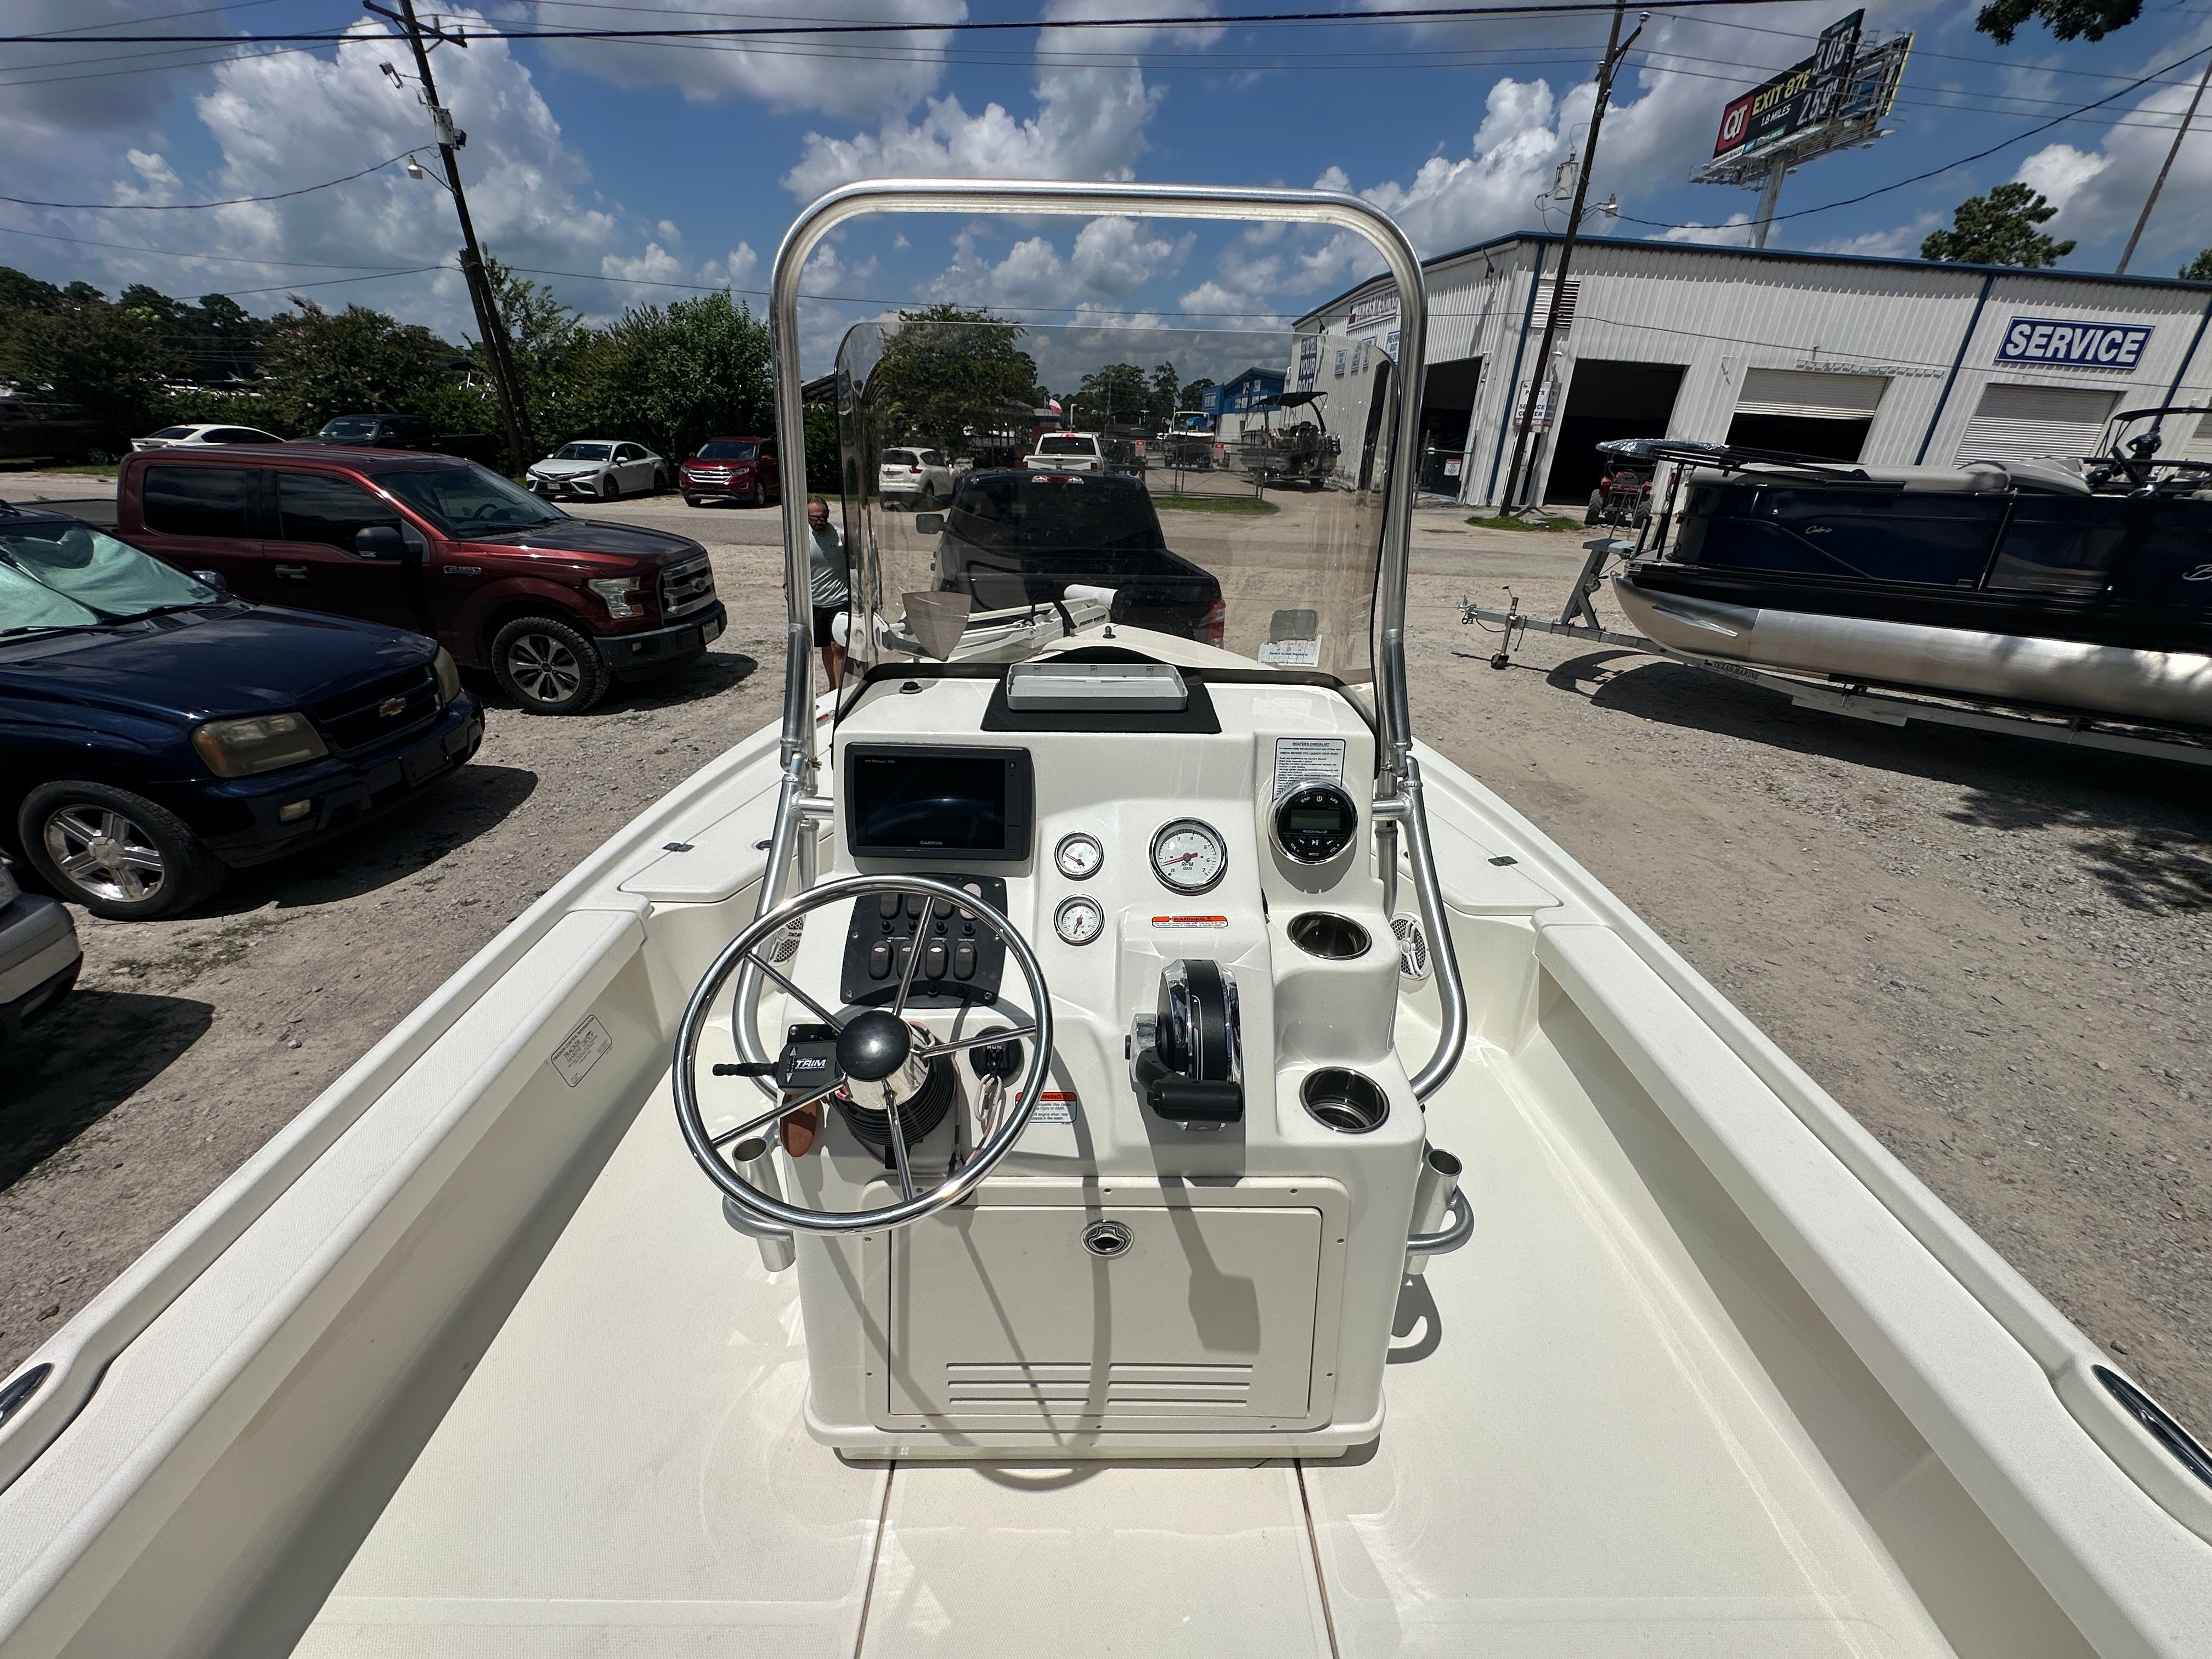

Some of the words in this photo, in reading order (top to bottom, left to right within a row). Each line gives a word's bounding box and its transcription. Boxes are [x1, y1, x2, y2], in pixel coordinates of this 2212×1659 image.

[1752, 83, 1784, 116] EXIT
[1784, 69, 1812, 99] 87E
[1723, 104, 1748, 140] QT
[1770, 104, 1791, 122] MILES
[2005, 324, 2147, 363] SERVICE
[1300, 358, 1316, 376] YOUR
[1297, 378, 1313, 392] BOAT
[1713, 662, 1734, 672] TEXAS
[1733, 668, 1759, 680] MARINE
[563, 1040, 580, 1058] TRACKER
[796, 1059, 827, 1068] TRIM
